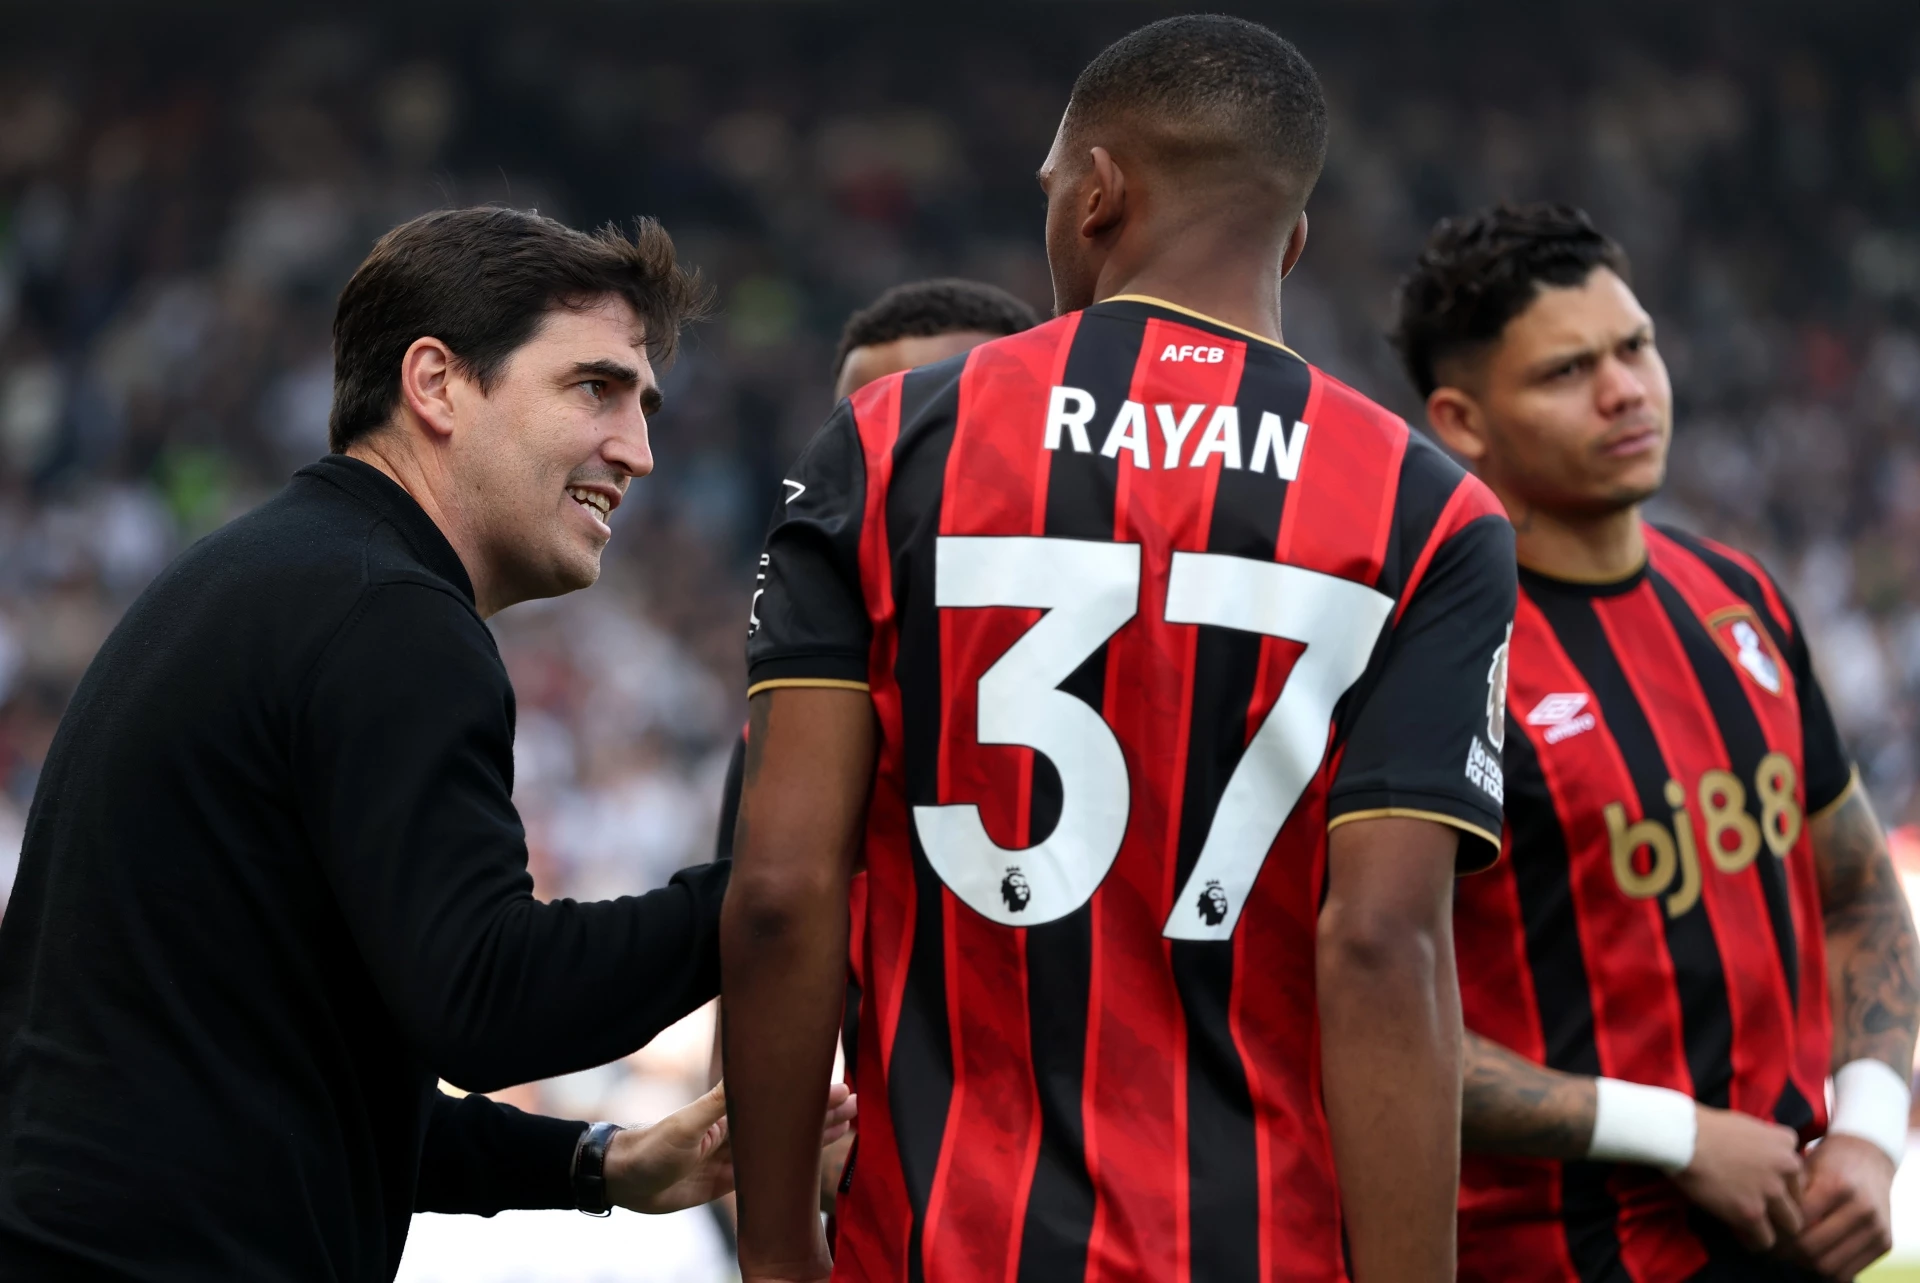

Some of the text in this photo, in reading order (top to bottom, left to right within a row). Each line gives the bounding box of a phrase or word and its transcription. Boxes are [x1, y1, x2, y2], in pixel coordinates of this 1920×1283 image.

[1160, 344, 1225, 363] AFCB
[1043, 385, 1309, 482] RAYAN
[912, 535, 1396, 941] 37
[1602, 753, 1802, 918] bj88
